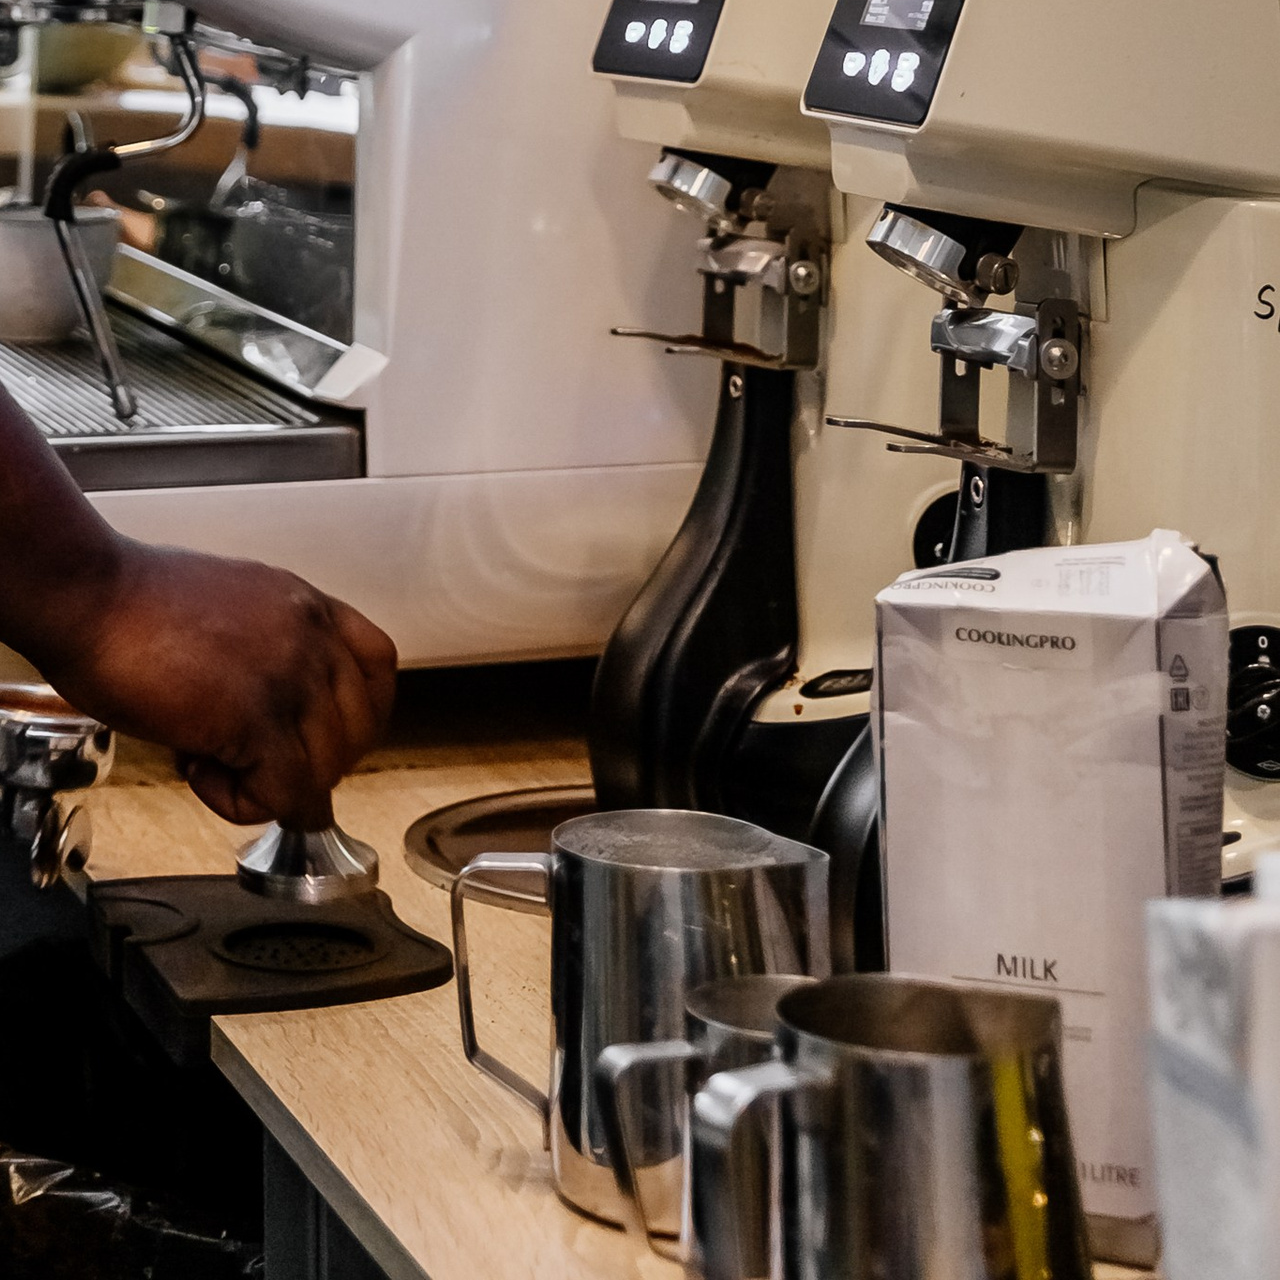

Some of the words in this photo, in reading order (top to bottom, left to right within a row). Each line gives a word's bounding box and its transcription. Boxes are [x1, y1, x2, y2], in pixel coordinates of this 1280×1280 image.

[955, 626, 1077, 651] COOKINGPRO
[996, 953, 1058, 982] MILK
[1091, 1163, 1141, 1189] LITRE
